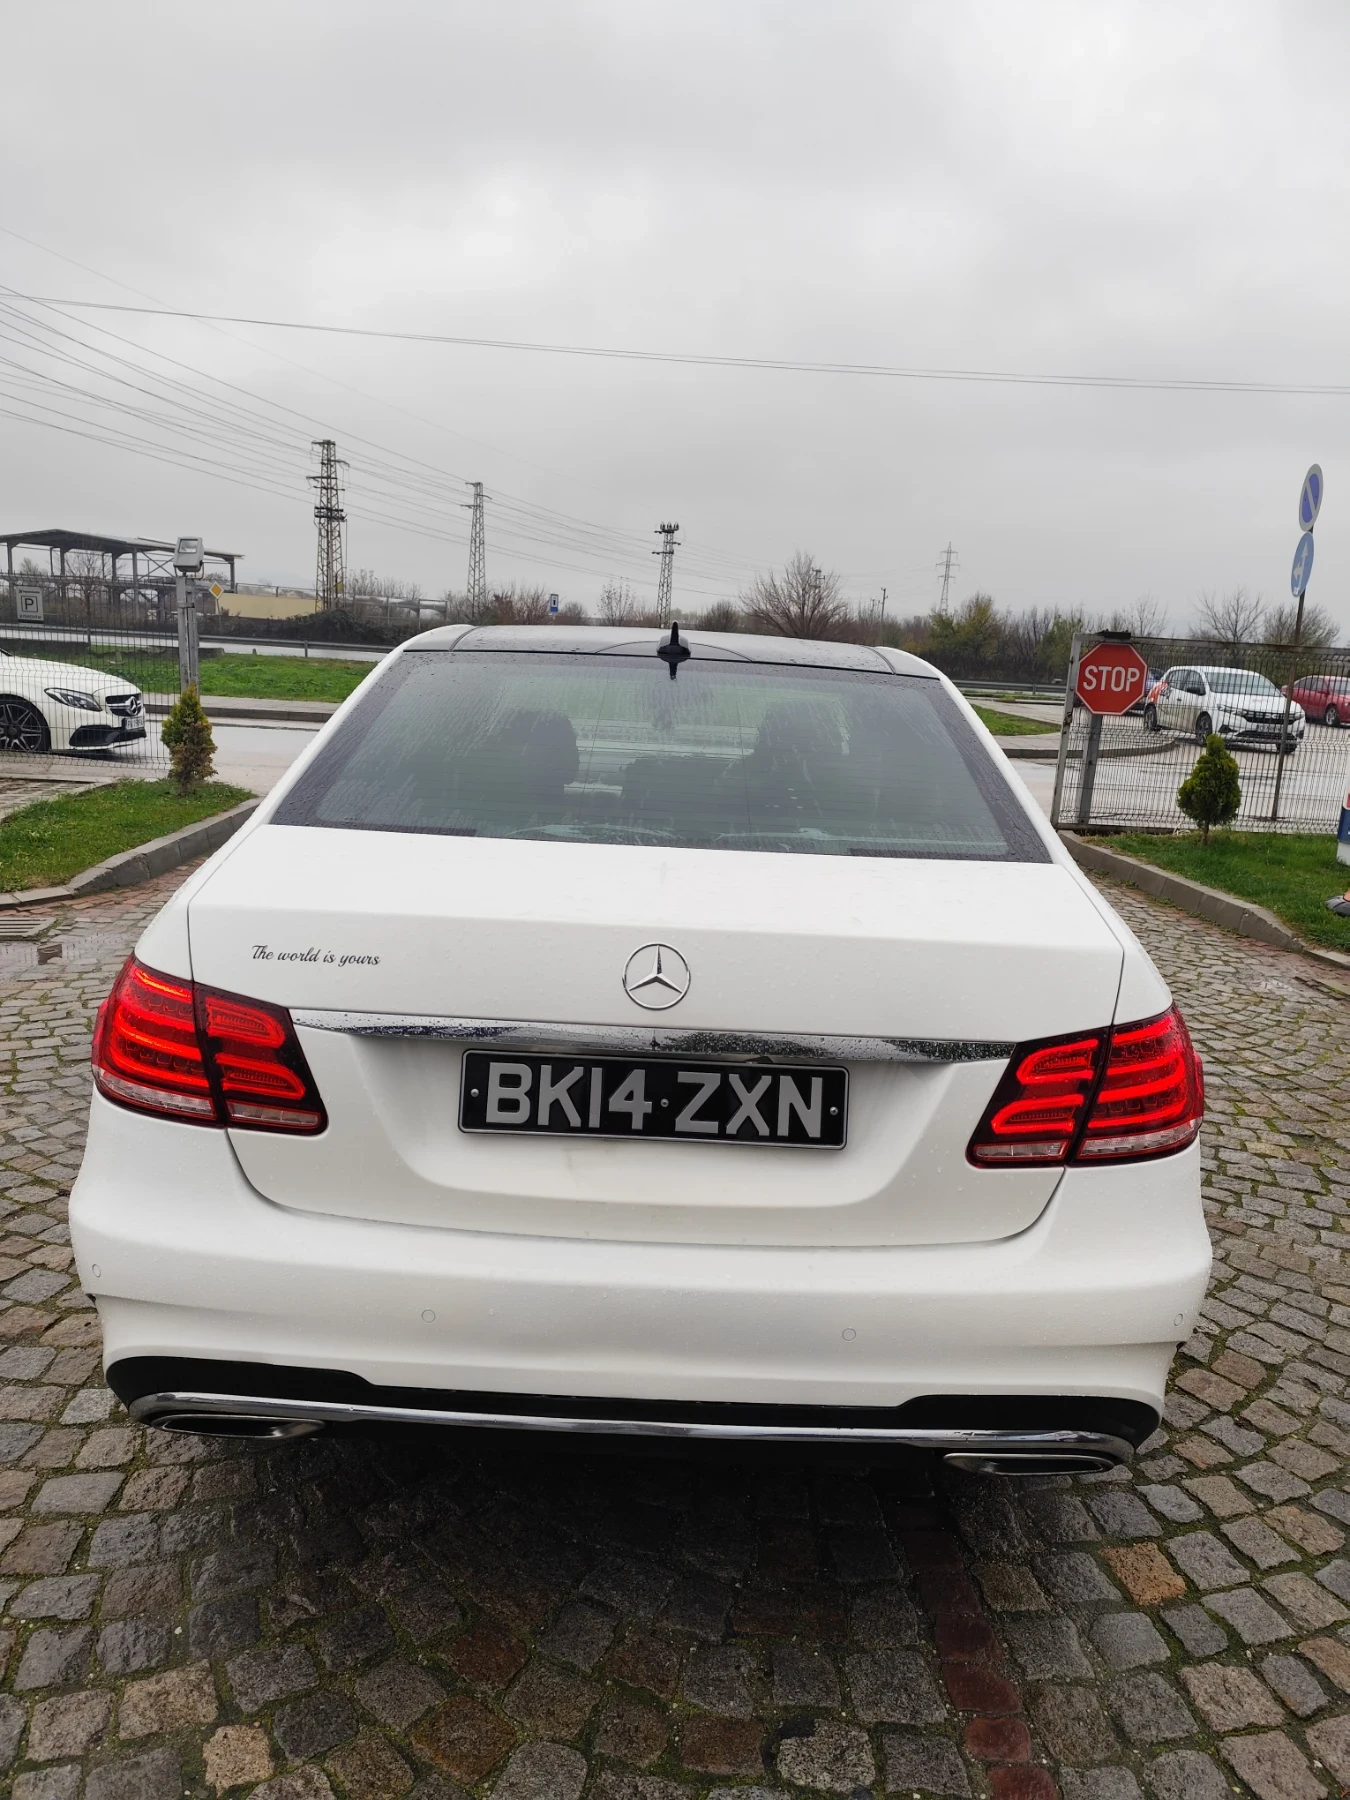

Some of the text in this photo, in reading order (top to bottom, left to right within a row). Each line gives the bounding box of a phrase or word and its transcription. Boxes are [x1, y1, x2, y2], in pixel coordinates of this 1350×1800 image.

[24, 597, 35, 611] P
[1083, 665, 1140, 693] STOP
[252, 945, 381, 967] The world is yours
[485, 1061, 823, 1138] BK14 ZXN
